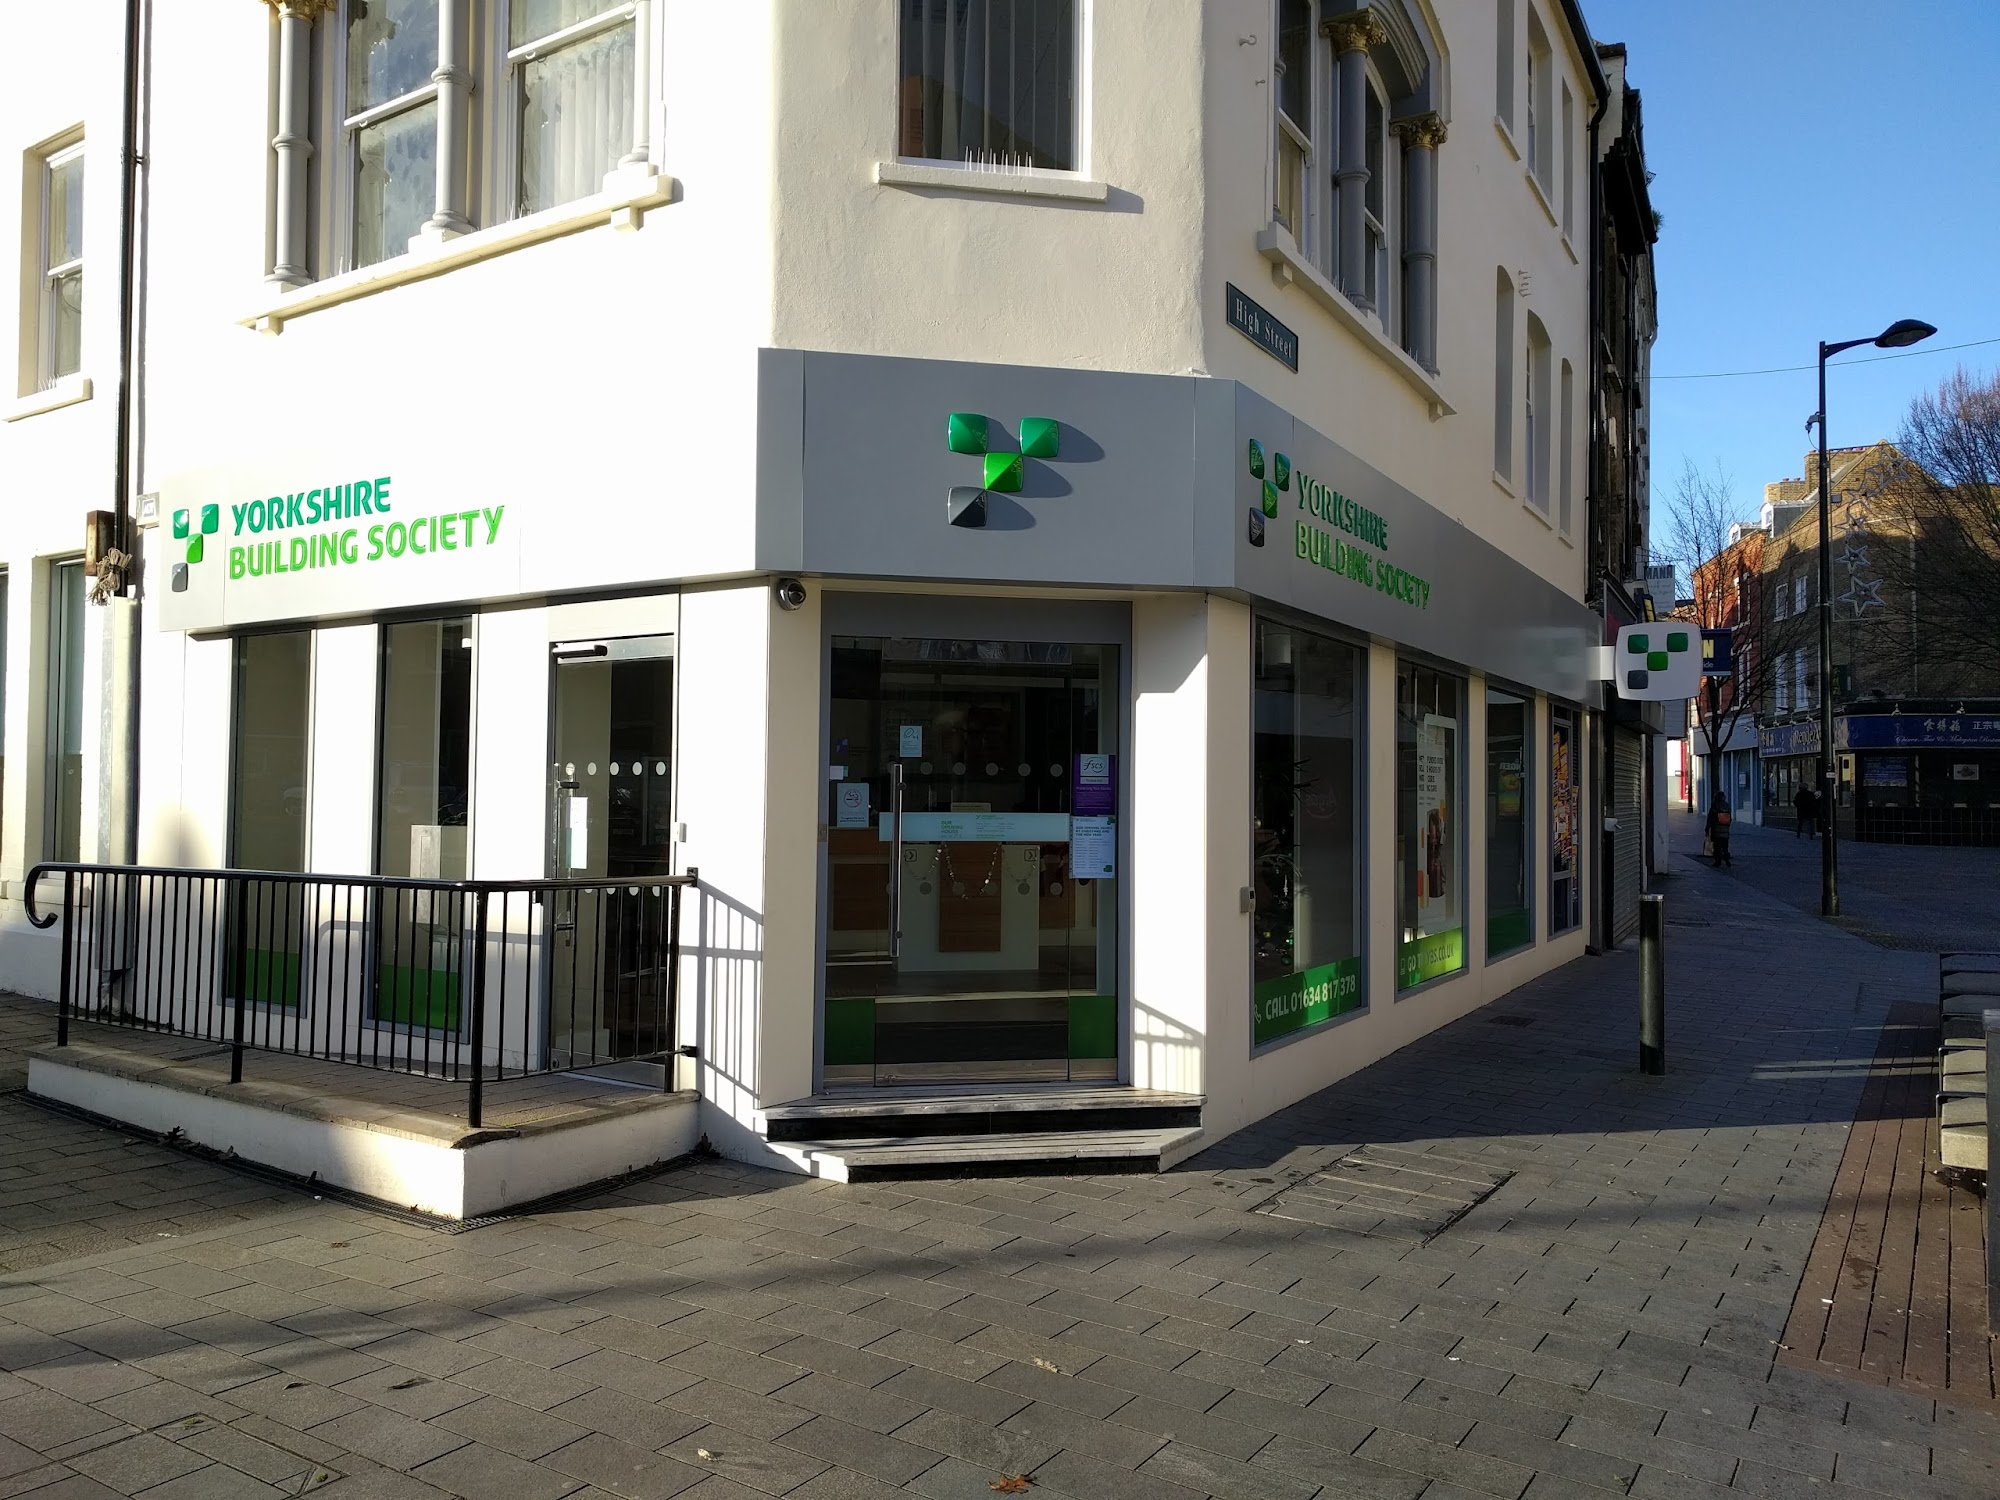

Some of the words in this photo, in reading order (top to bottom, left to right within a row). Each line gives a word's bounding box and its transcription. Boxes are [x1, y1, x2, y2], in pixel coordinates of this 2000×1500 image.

[1236, 298, 1260, 335] High
[1265, 320, 1292, 359] Street
[231, 476, 391, 536] YORKSHIRE
[1297, 470, 1388, 551] YORKSHIRE
[229, 528, 358, 580] BUILDING
[367, 505, 505, 562] SOCIETY
[1296, 519, 1374, 587] BUILDING
[1375, 558, 1430, 610] SOCIETY
[1644, 566, 1673, 579] MANN
[1407, 954, 1417, 972] GO
[1265, 994, 1289, 1020] CALL
[1291, 984, 1320, 1012] 01634
[1322, 979, 1339, 1002] 817
[1340, 974, 1356, 996] 378
